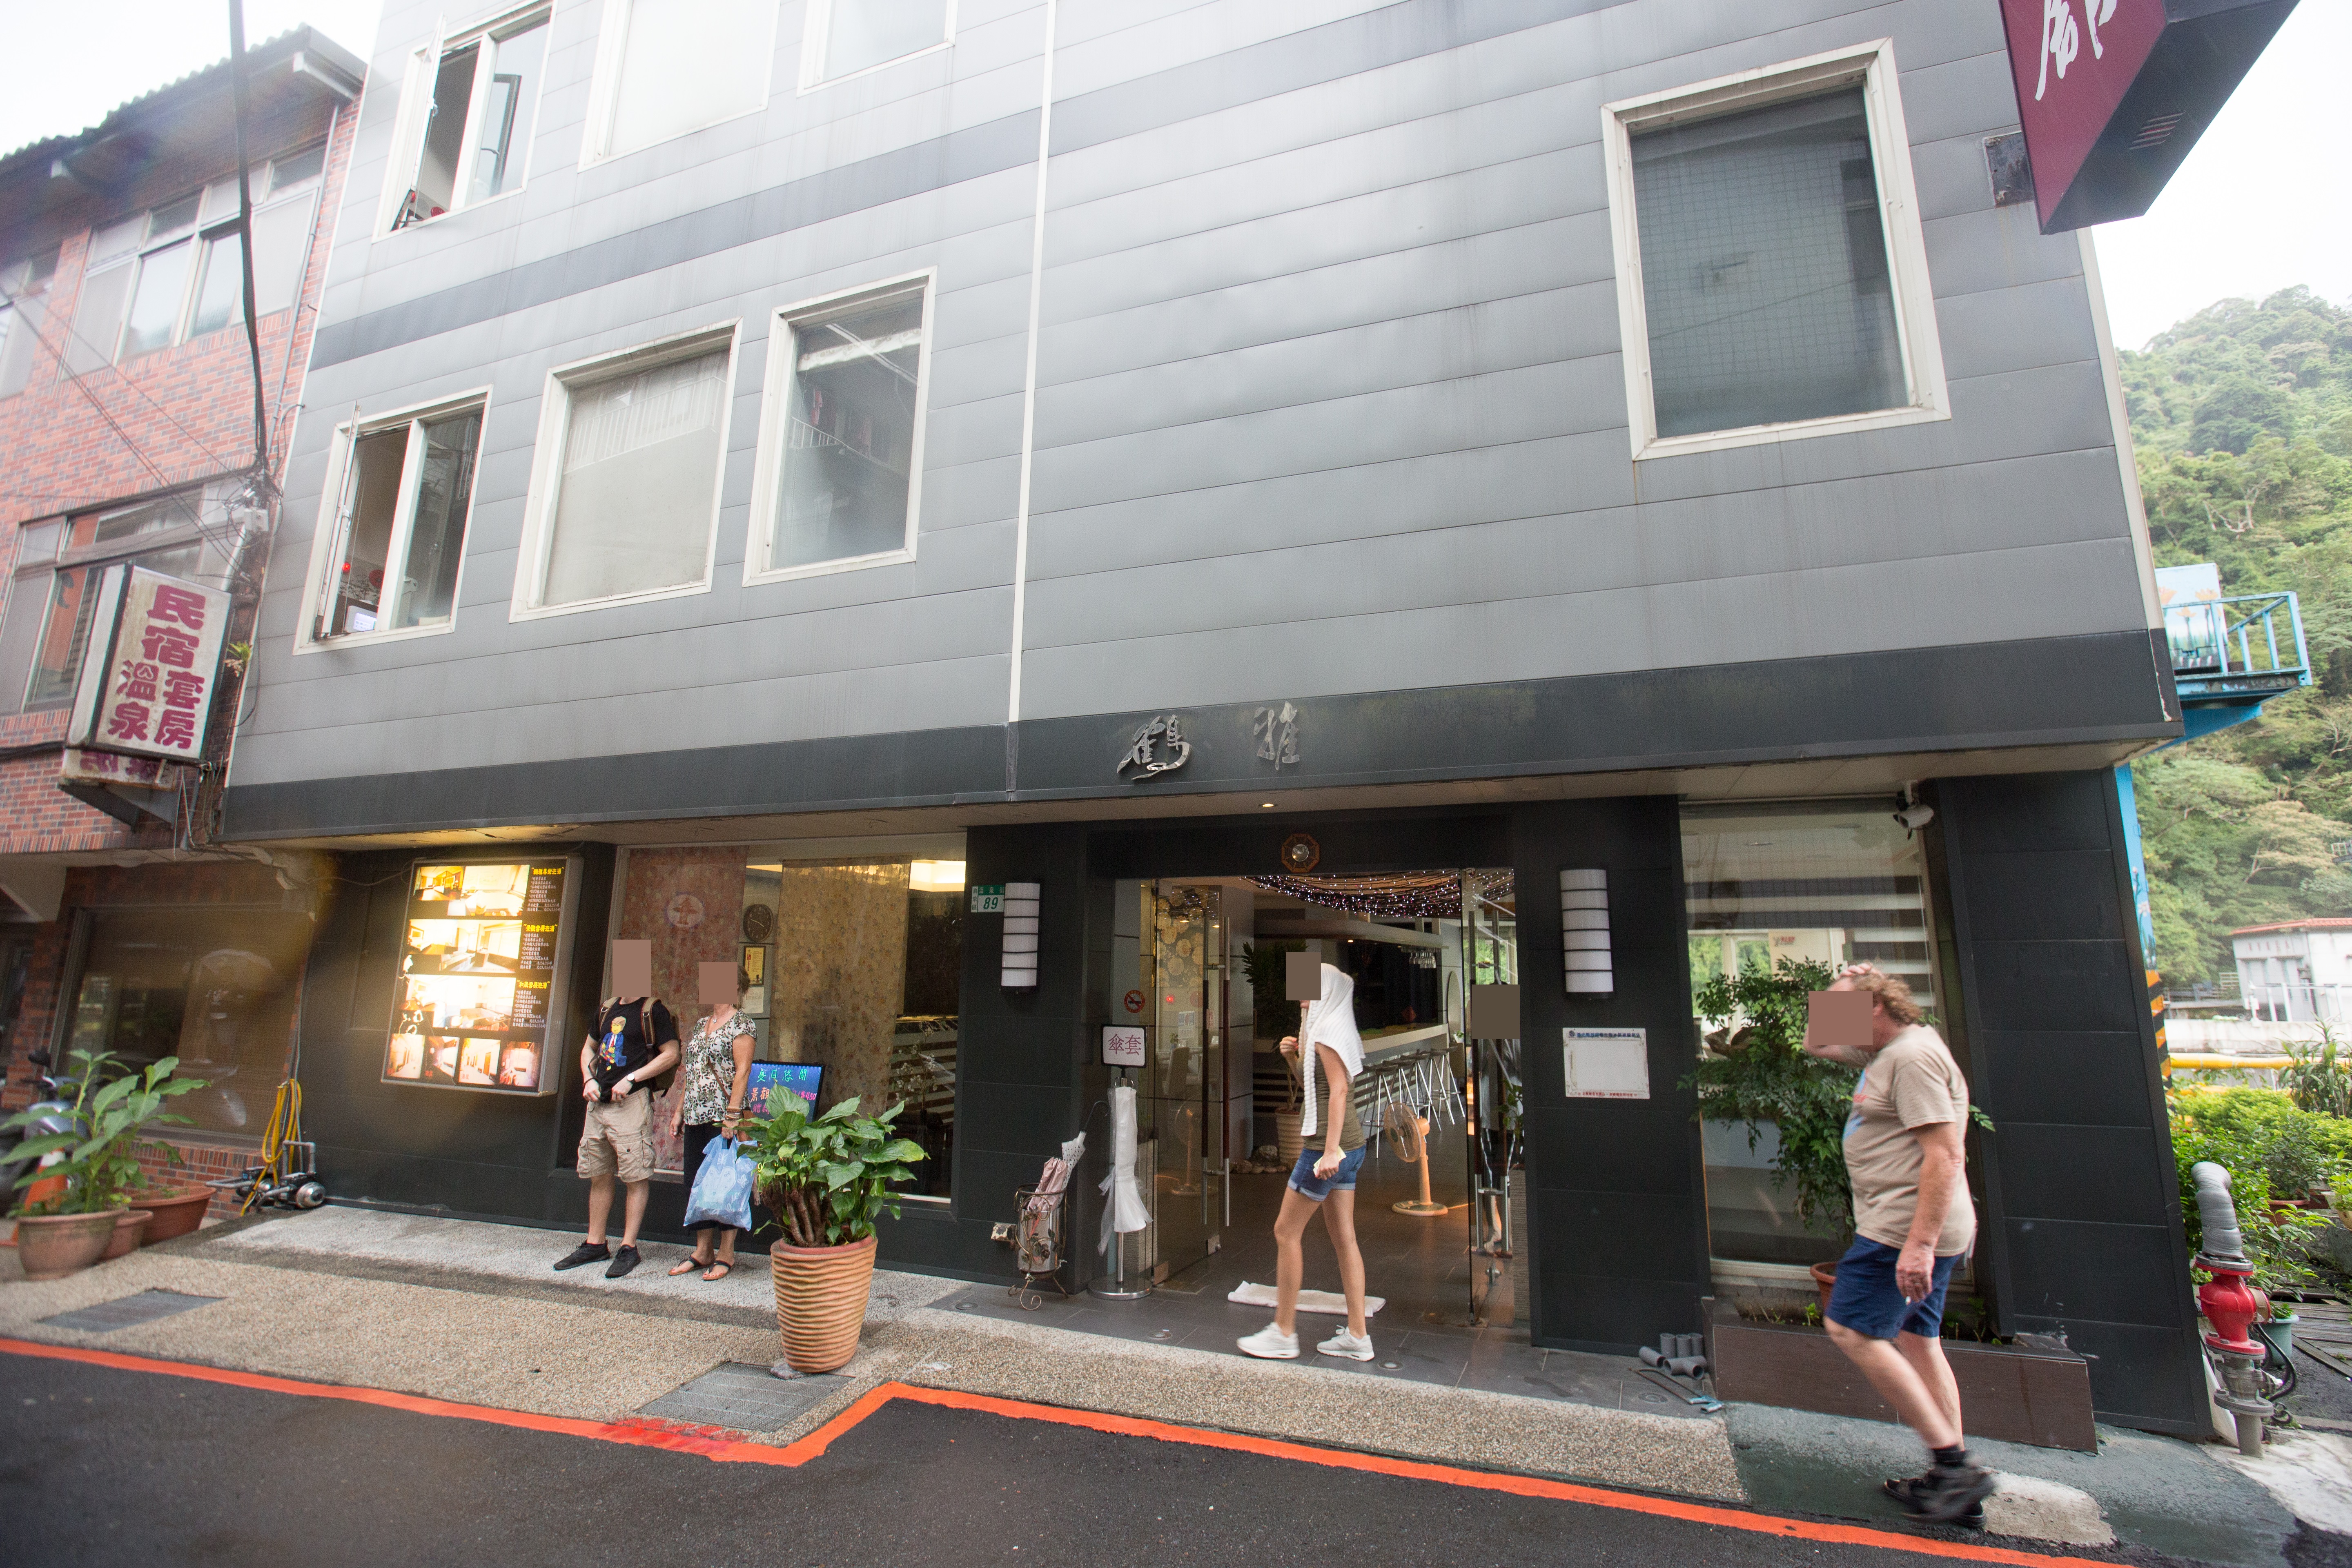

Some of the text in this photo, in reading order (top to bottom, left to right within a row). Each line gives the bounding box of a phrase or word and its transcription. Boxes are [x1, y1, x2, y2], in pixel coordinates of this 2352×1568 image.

[141, 584, 206, 669] 民宿
[107, 660, 159, 741] 溫泉
[154, 670, 205, 749] 套房
[983, 897, 998, 910] 89
[1108, 1033, 1142, 1055] 傘套
